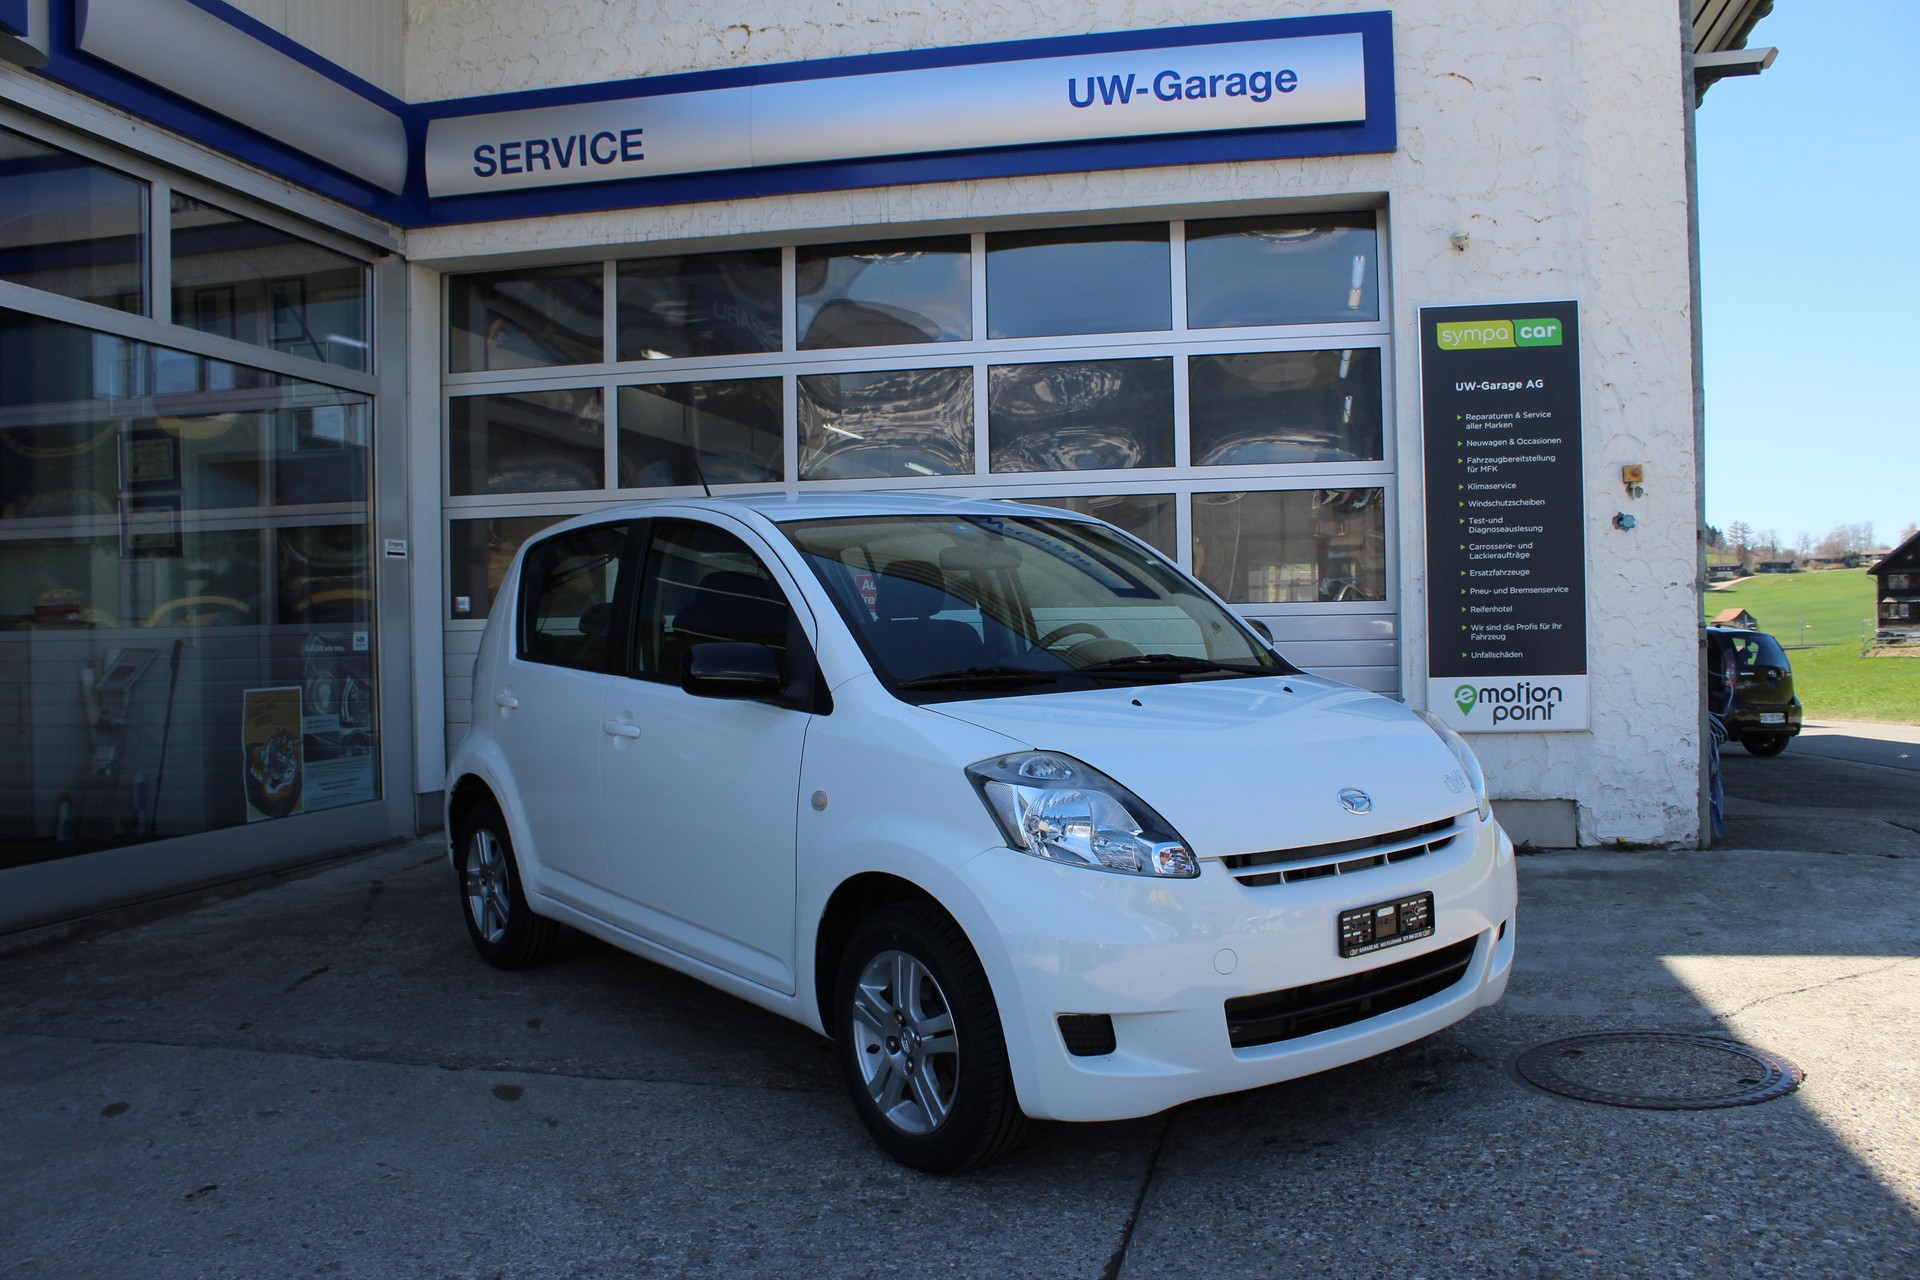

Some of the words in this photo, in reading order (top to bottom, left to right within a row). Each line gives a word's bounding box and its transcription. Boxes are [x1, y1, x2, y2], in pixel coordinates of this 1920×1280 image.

[1068, 69, 1298, 108] UW-Garage
[473, 128, 645, 178] SERVICE
[1441, 327, 1509, 346] sympa
[1520, 323, 1557, 339] car
[1455, 380, 1523, 392] UW-Garage
[1526, 379, 1544, 389] AG
[1465, 412, 1514, 422] Reparaturen
[1515, 411, 1521, 419] &
[1522, 410, 1552, 419] Service
[1465, 421, 1483, 430] aller
[1484, 421, 1514, 429] Marken
[1466, 439, 1508, 448] Neuwagen
[1509, 438, 1515, 446] &
[1516, 436, 1562, 446] Occasionen
[1466, 454, 1556, 465] Fahrzeugbereitstellung
[1466, 465, 1479, 474] für
[1480, 465, 1498, 473] MFK
[1467, 481, 1517, 491] Klimaservice
[1467, 498, 1546, 508] Windschutzscheiben
[1468, 525, 1544, 535] Diagnoseauslesung
[1468, 542, 1516, 551] Carrosserie-
[1517, 541, 1534, 550] und
[1469, 551, 1531, 561] Lackieraufträge
[1469, 568, 1531, 578] Ersatzfahrzeuge
[1469, 586, 1492, 595] Pneu-
[1493, 586, 1508, 595] und
[1509, 585, 1569, 594] Bremsenservice
[1470, 605, 1513, 613] Reifenhotel
[1470, 623, 1485, 631] Wir
[1485, 623, 1502, 631] sind
[1502, 623, 1515, 631] die
[1516, 622, 1539, 631] Profis
[1539, 621, 1551, 631] für
[1551, 622, 1563, 630] Ihr
[1470, 633, 1506, 643] Fahrzeug
[1470, 650, 1524, 659] Unfallschäden
[1493, 703, 1555, 725] point
